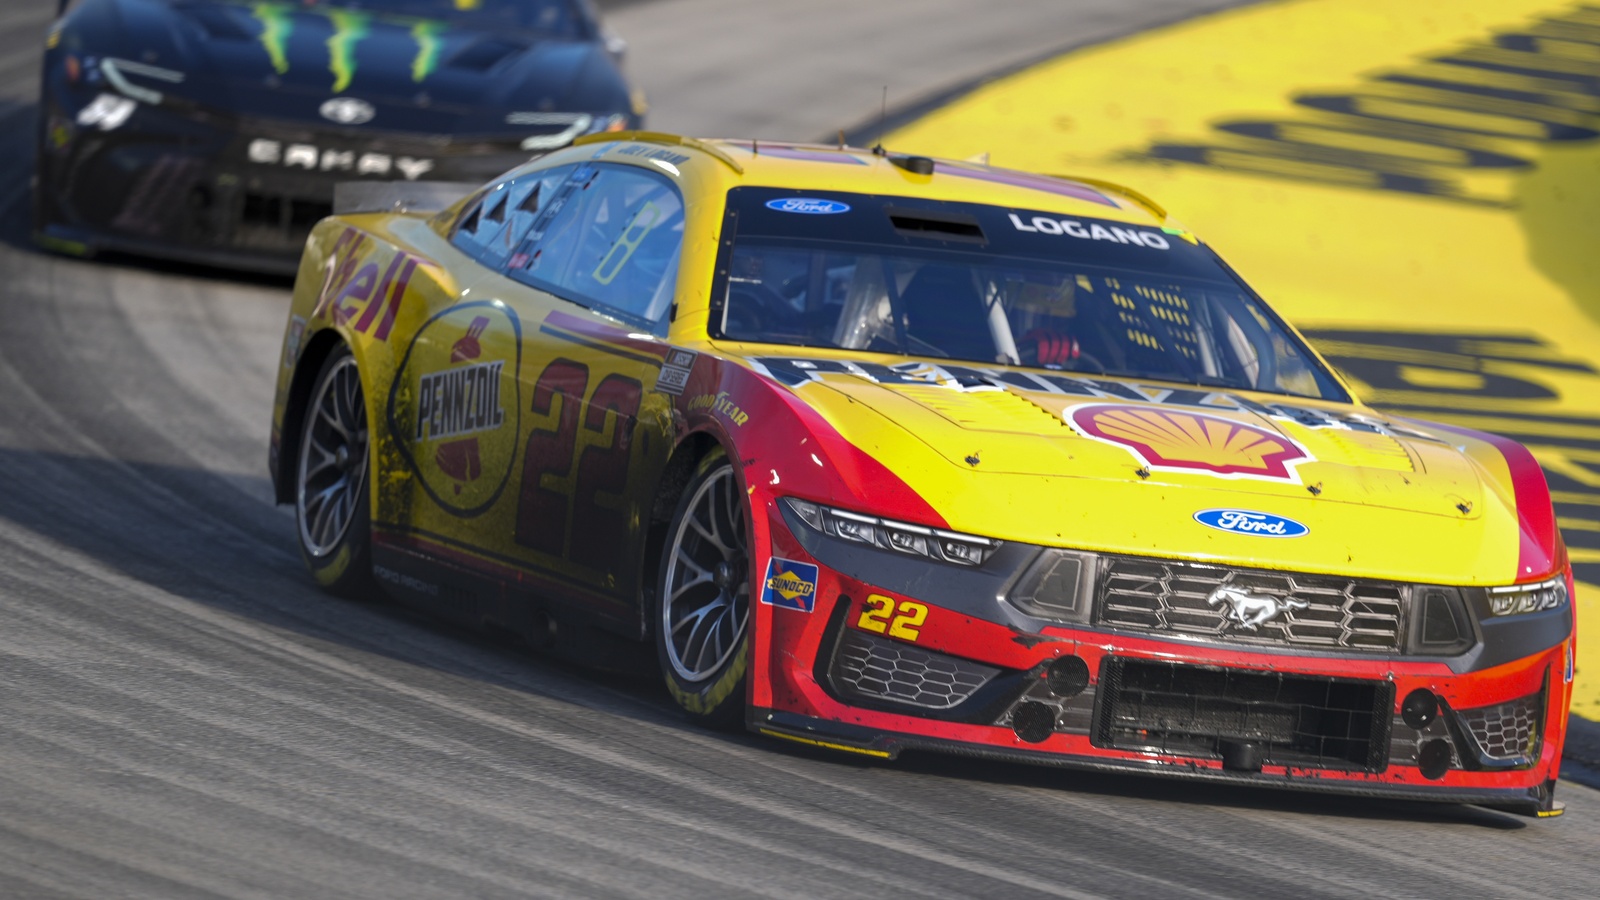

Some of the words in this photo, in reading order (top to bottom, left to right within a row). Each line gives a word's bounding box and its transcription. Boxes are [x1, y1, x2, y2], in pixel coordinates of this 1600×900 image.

[1008, 213, 1170, 250] LOGANO
[416, 360, 505, 442] PENNZOIL
[514, 357, 643, 571] 22
[770, 577, 812, 595] SUNOCO
[857, 593, 929, 642] 22
